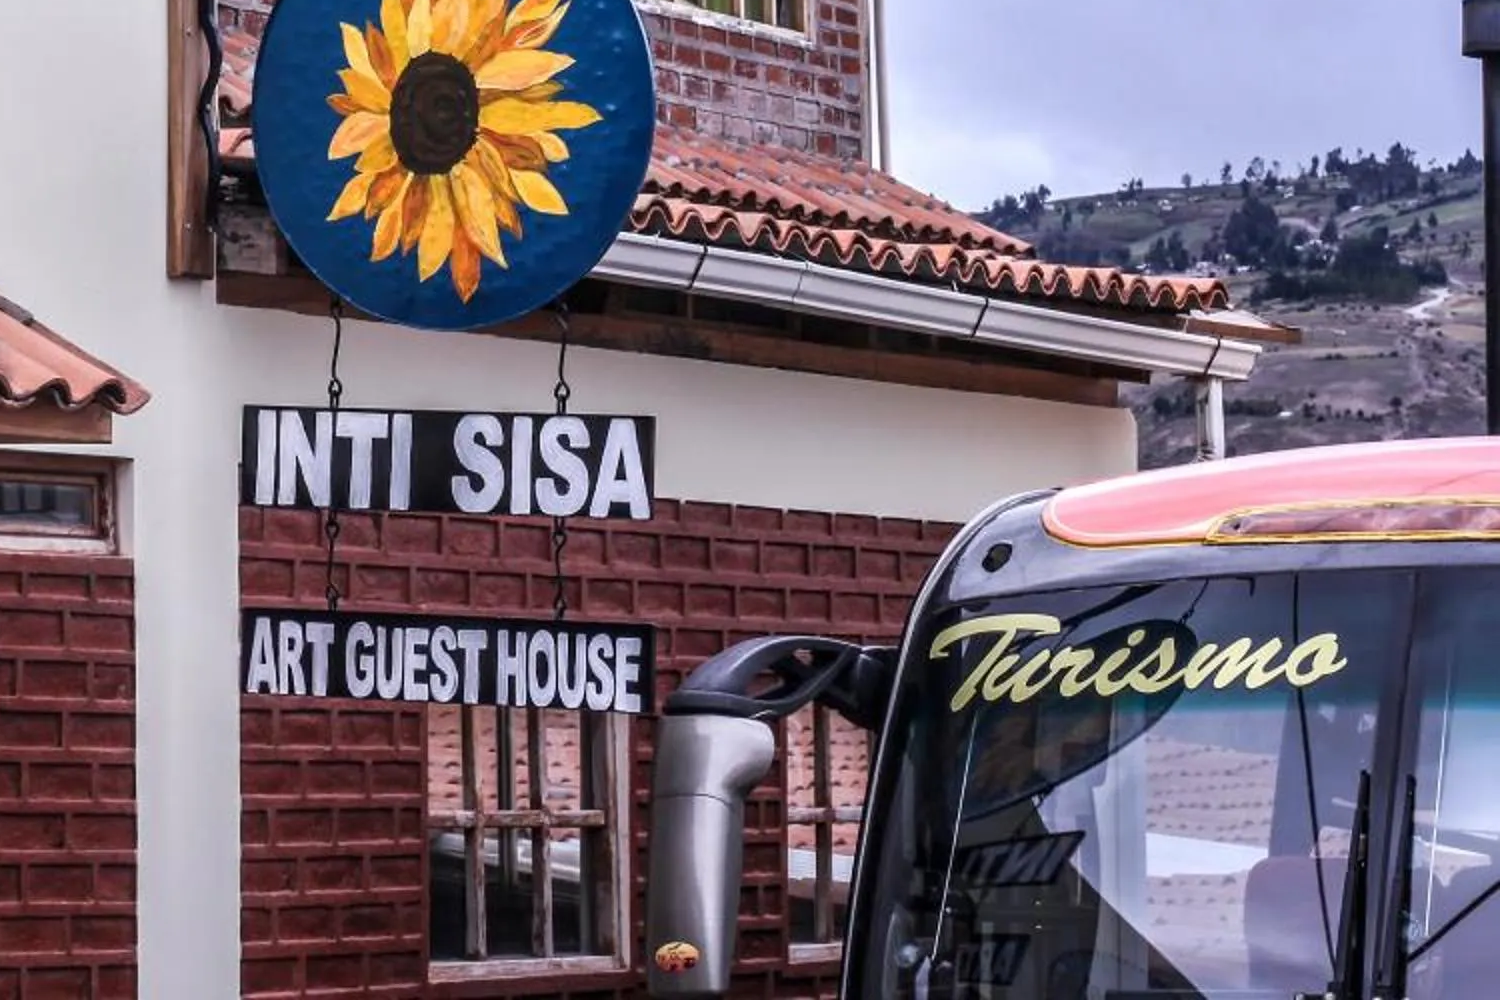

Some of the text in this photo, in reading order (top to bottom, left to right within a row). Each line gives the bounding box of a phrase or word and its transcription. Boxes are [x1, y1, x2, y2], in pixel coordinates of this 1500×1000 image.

[253, 409, 651, 521] INTI SISA
[246, 617, 642, 713] ART GUEST HOUSE
[929, 613, 1347, 713] Turismo
